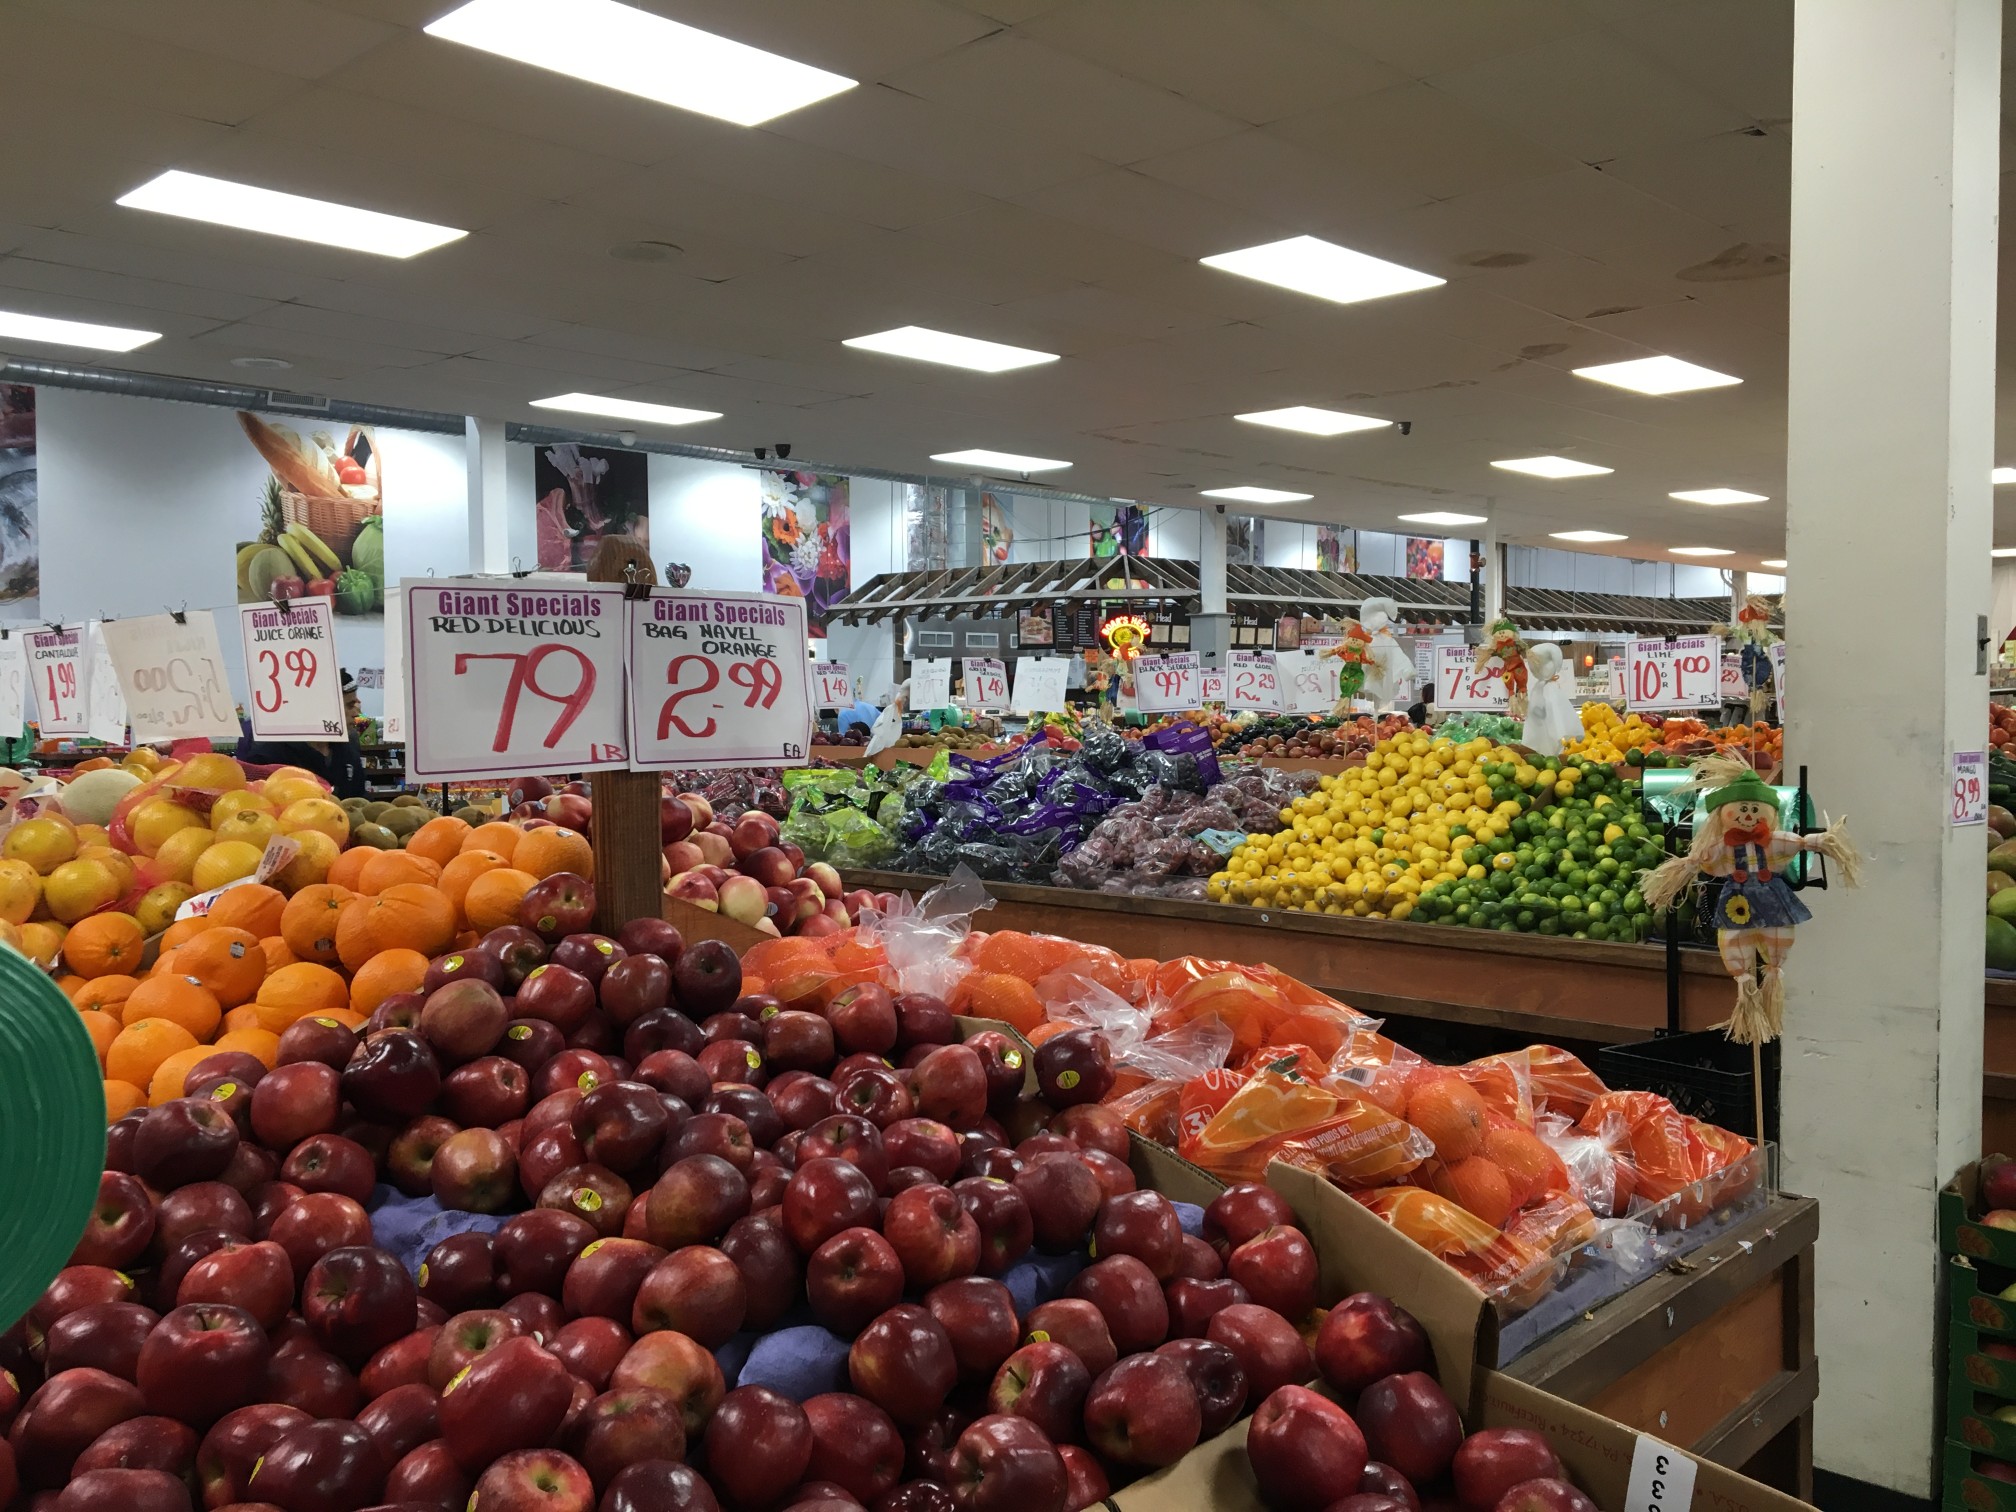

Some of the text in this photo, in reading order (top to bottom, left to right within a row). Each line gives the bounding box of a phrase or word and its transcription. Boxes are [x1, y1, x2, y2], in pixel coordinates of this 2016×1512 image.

[438, 591, 601, 618] Giant Specials
[252, 607, 319, 629] Giant Specials
[654, 600, 786, 626] Giant Specials
[254, 626, 325, 642] JUICE ORANGE
[428, 616, 601, 638] RED DELICIOUS
[642, 623, 762, 641] BAG NAVEL
[1102, 616, 1129, 636] BOAR'S
[34, 634, 57, 648] Giant
[1638, 639, 1706, 652] Giant Specials
[702, 641, 777, 658] ORANGE
[1446, 648, 1466, 656] Giant
[1139, 664, 1164, 673] BLACK
[1142, 656, 1190, 667] Giant Specials
[454, 643, 597, 753] 79
[322, 720, 343, 736] BAG
[783, 743, 801, 758] EA
[1957, 765, 1976, 774] MANGO
[1318, 1128, 1341, 1147] POIDS
[1338, 1123, 1354, 1137] NET
